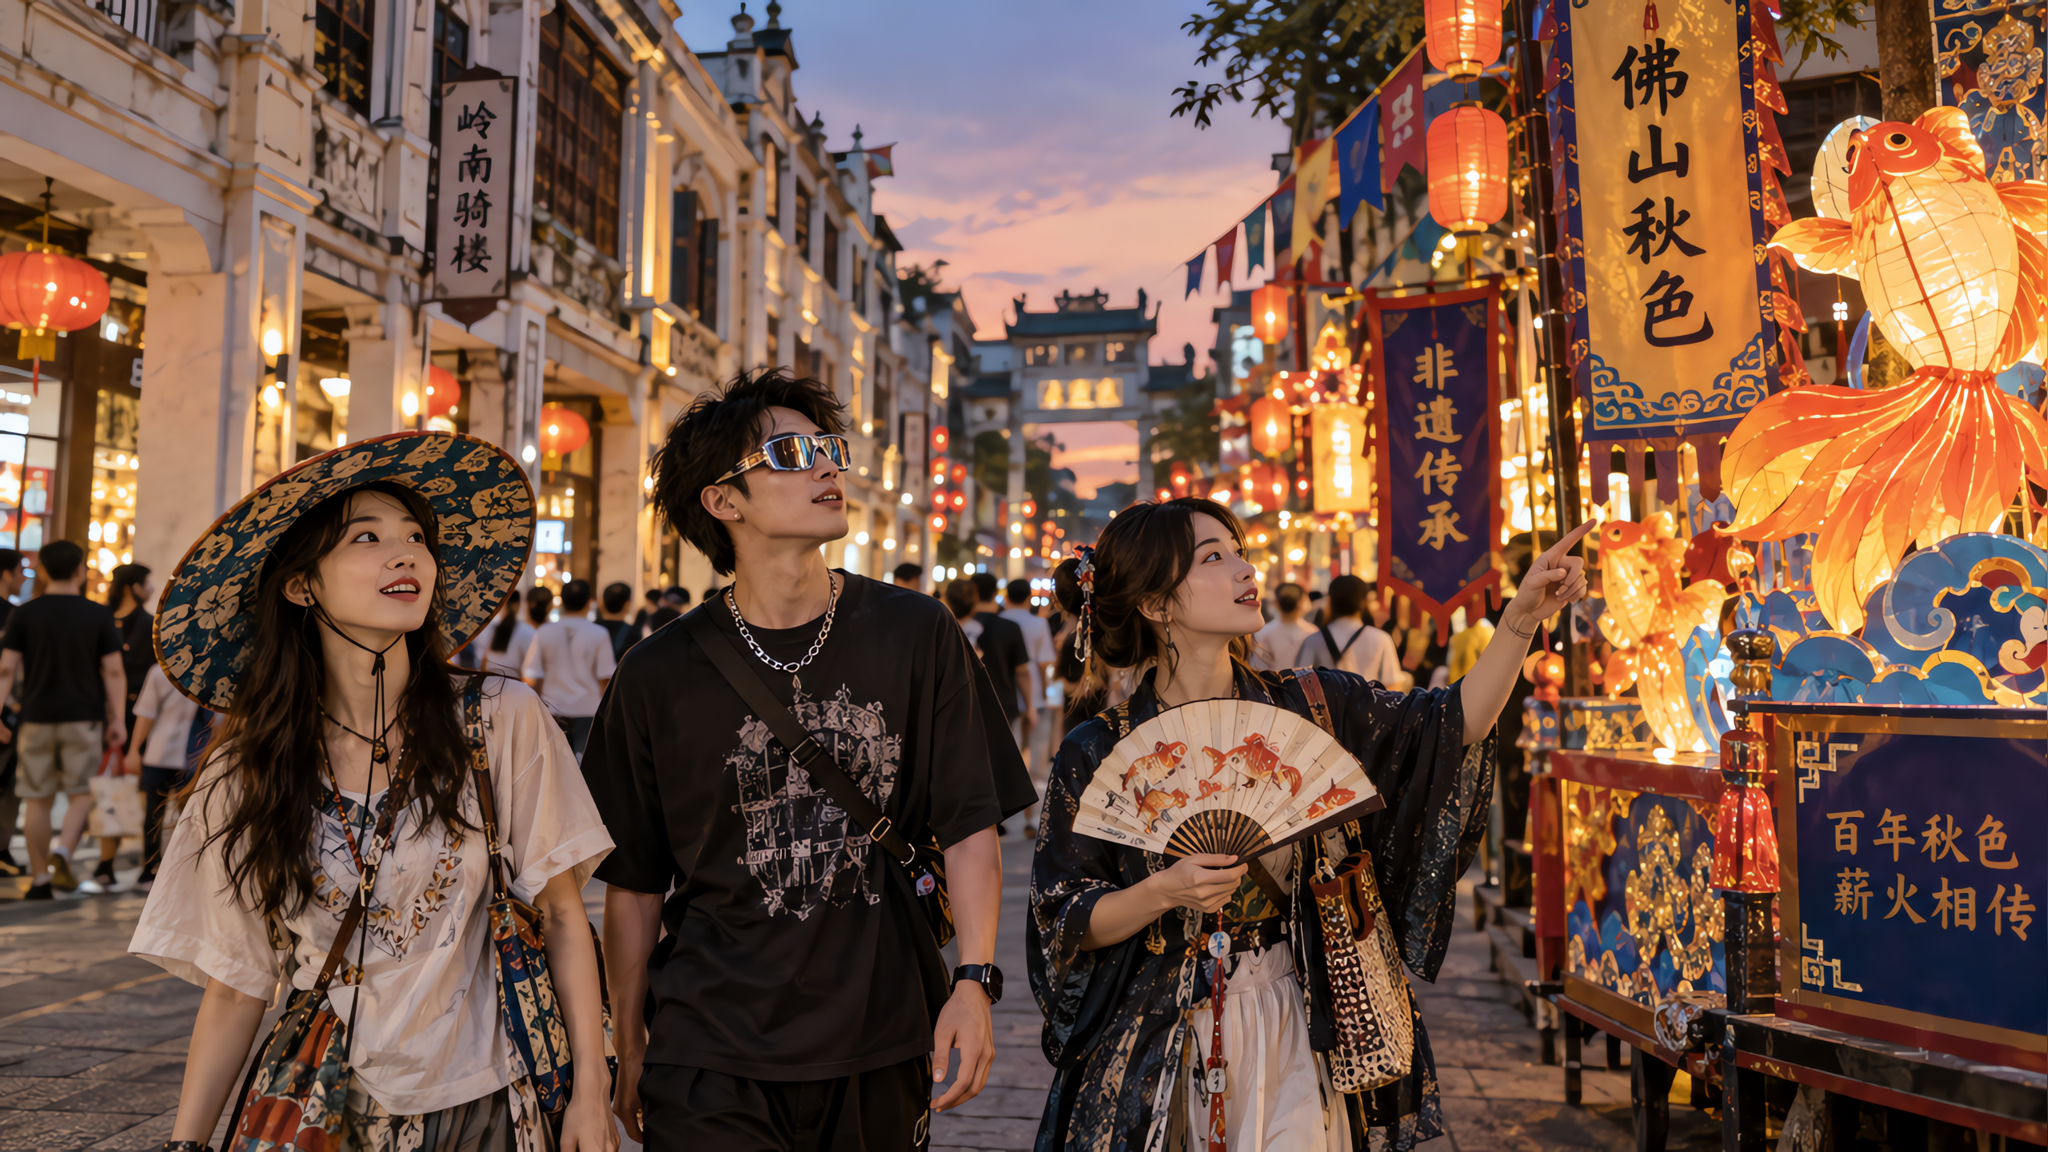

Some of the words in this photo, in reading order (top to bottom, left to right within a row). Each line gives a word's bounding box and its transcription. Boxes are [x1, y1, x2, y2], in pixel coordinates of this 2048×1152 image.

[450, 100, 497, 274] 岭南骑楼
[1611, 37, 1714, 348] 佛山秋色
[1413, 342, 1469, 551] 非遗传承
[1826, 808, 2019, 870] 百年秋色
[1834, 867, 2036, 941] 薪火相传
